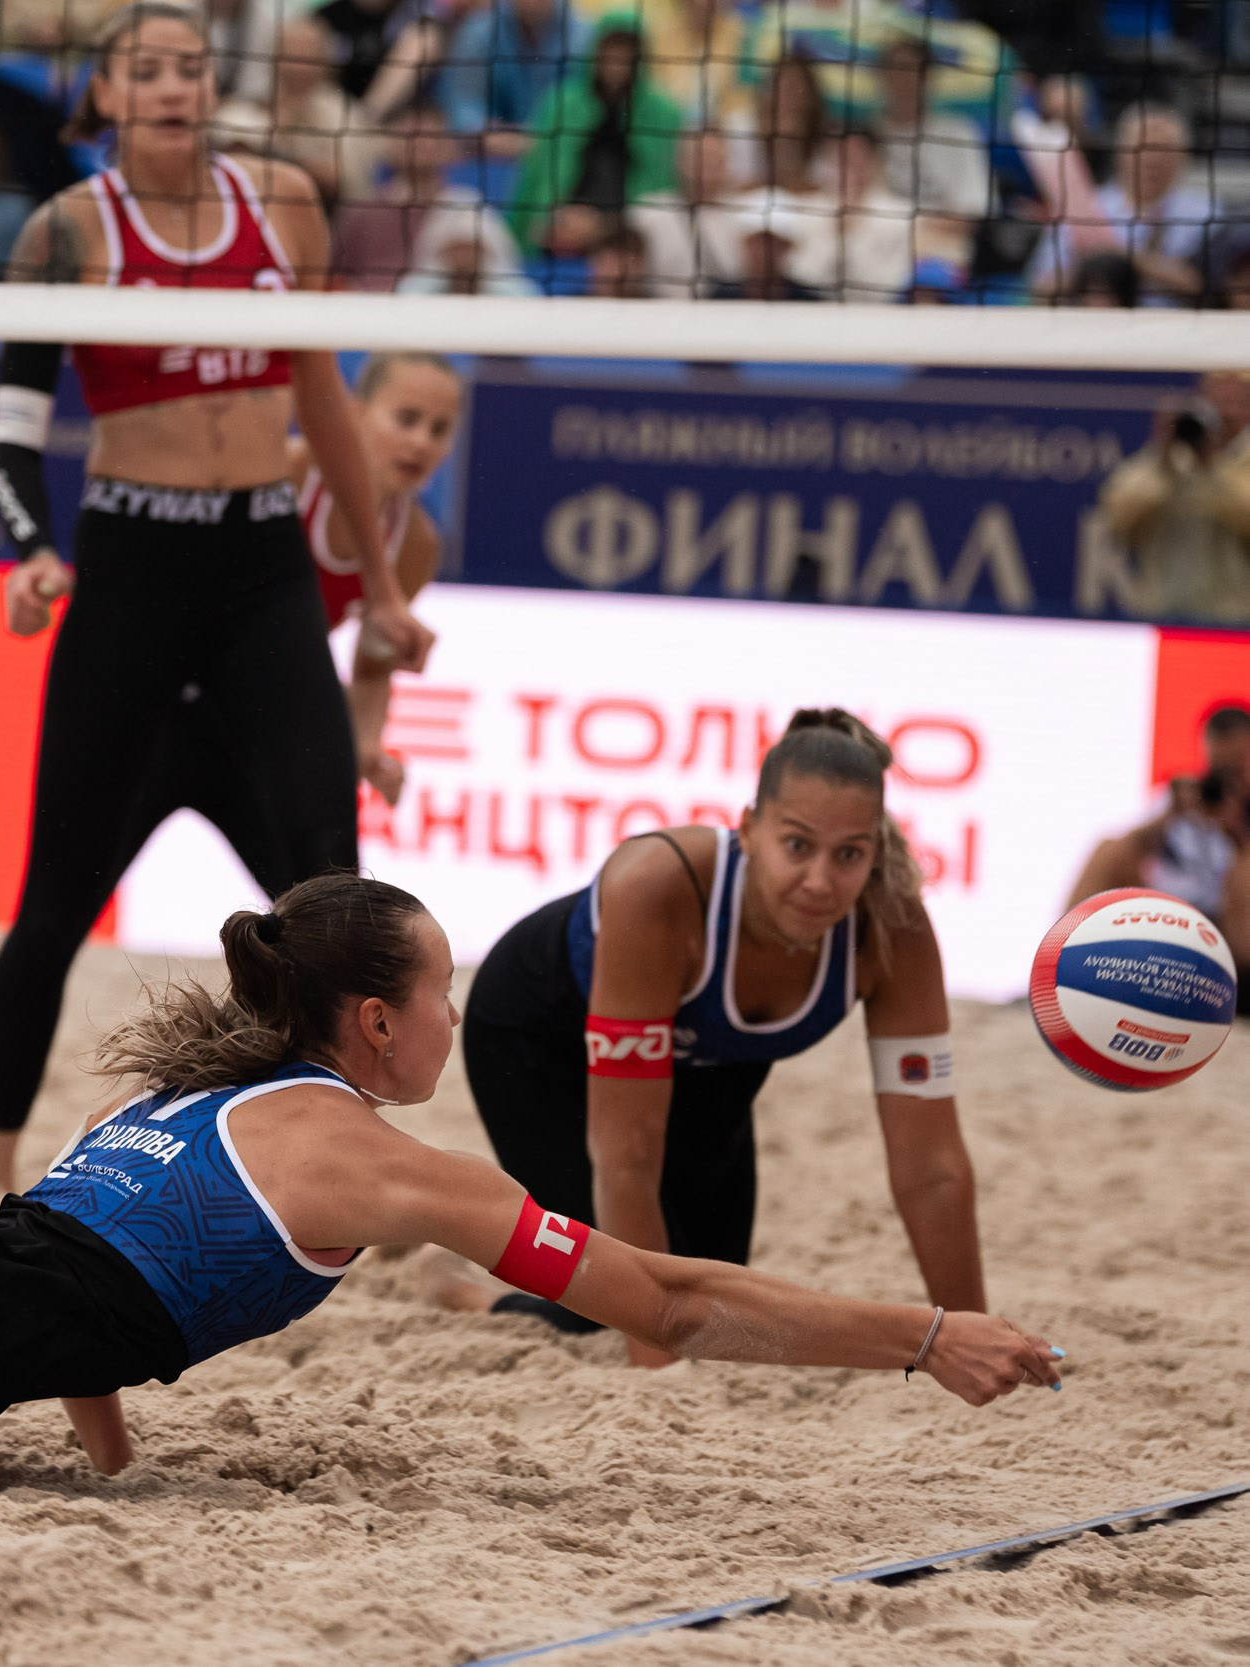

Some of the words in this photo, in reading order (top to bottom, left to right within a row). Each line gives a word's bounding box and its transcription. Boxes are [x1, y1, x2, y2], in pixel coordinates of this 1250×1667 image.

[543, 483, 1037, 615] ФИНАЛ
[511, 692, 982, 792] ТОЛО
[1108, 1033, 1166, 1062] ВФВ
